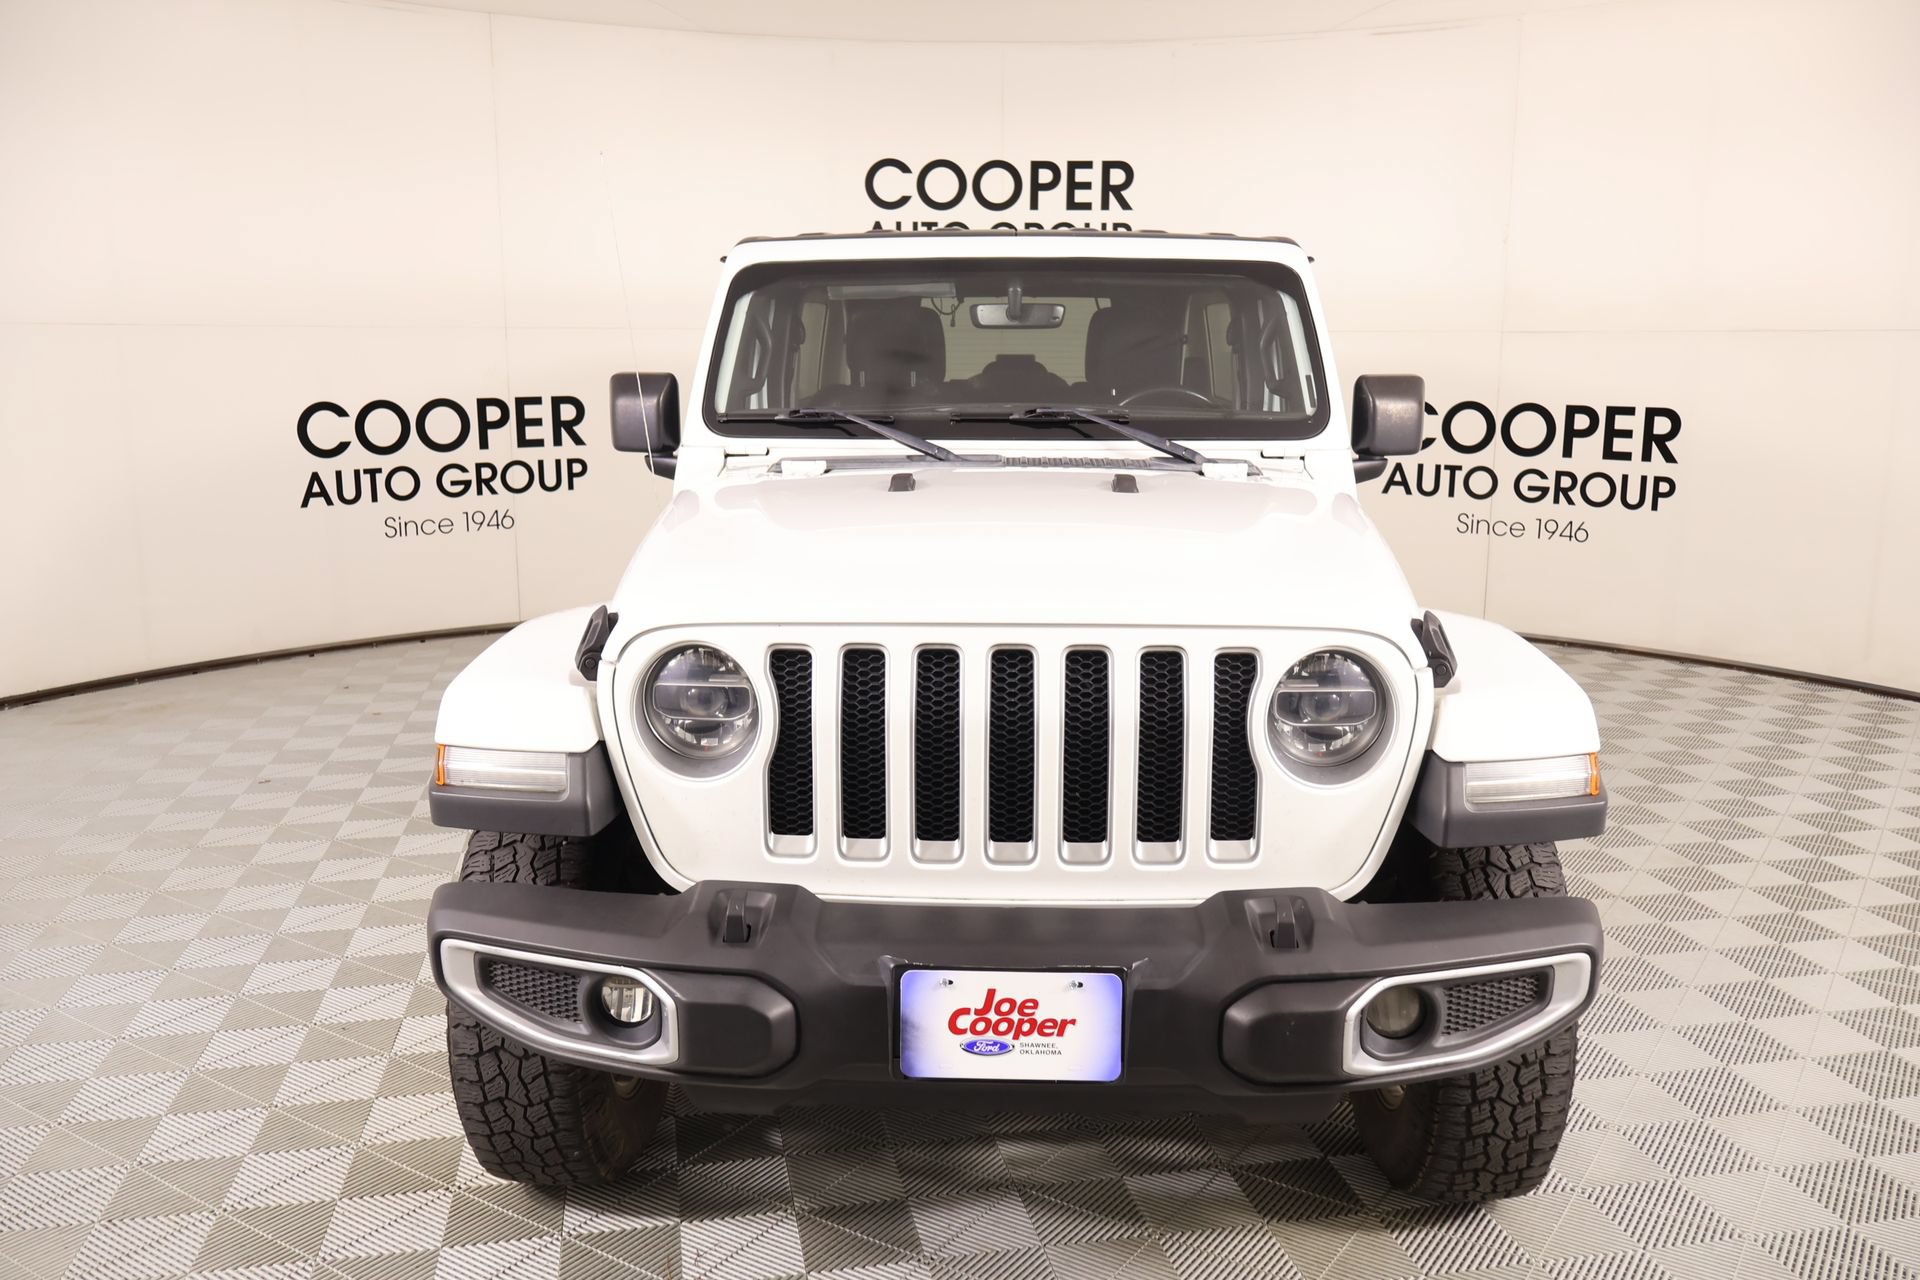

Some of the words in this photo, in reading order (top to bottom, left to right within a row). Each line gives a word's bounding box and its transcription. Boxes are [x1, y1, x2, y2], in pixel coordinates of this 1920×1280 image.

[865, 158, 1134, 211] COOPER
[297, 395, 587, 459] COOPER
[1422, 400, 1682, 464] OOPER
[300, 465, 421, 508] AUTO
[436, 458, 588, 498] GROUP
[1381, 462, 1498, 500] AUTO
[1514, 468, 1676, 511] GROUP
[384, 516, 454, 538] Since
[463, 508, 515, 532] 1946
[1456, 512, 1526, 538] Since
[1536, 518, 1589, 542] 1946
[974, 988, 1039, 1017] Joe
[948, 1007, 1076, 1040] Cooper
[973, 1040, 1000, 1052] Ford
